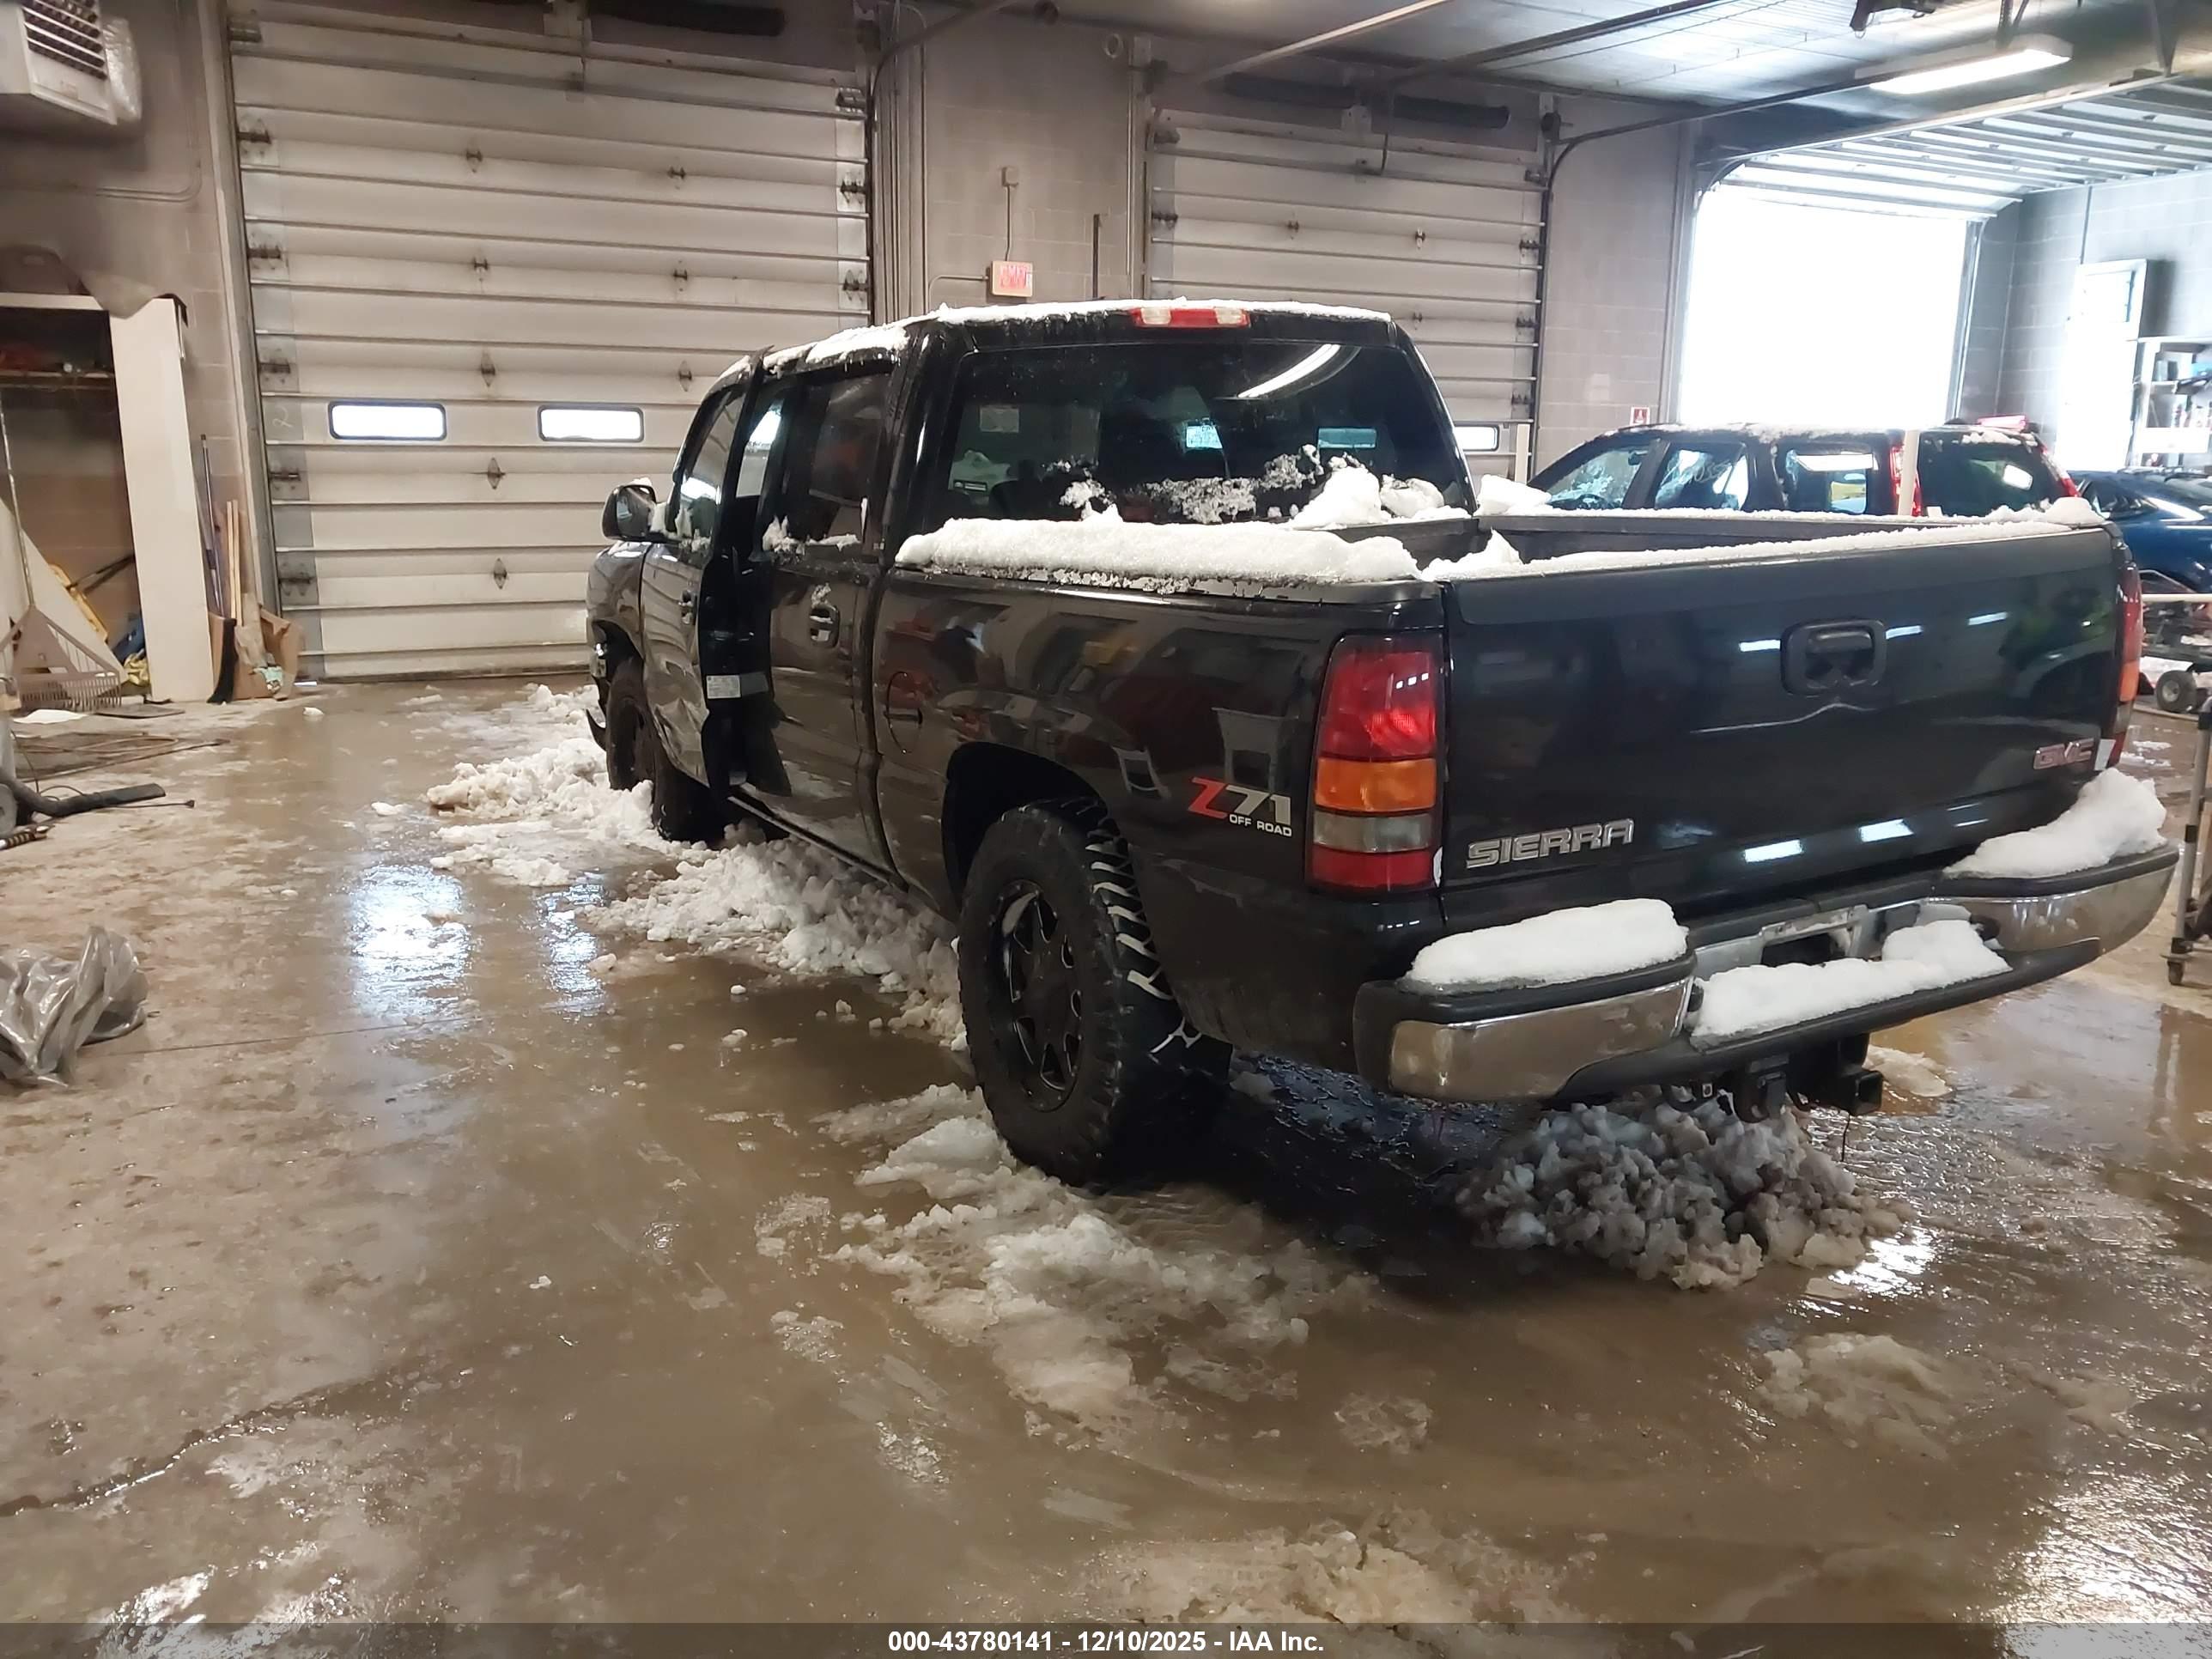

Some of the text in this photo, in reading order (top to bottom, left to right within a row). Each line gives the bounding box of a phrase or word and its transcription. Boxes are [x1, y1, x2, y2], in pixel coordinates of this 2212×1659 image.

[1188, 776, 1291, 826] Z71
[1229, 813, 1292, 837] OFF ROAD
[1466, 817, 1635, 869] SIERRA
